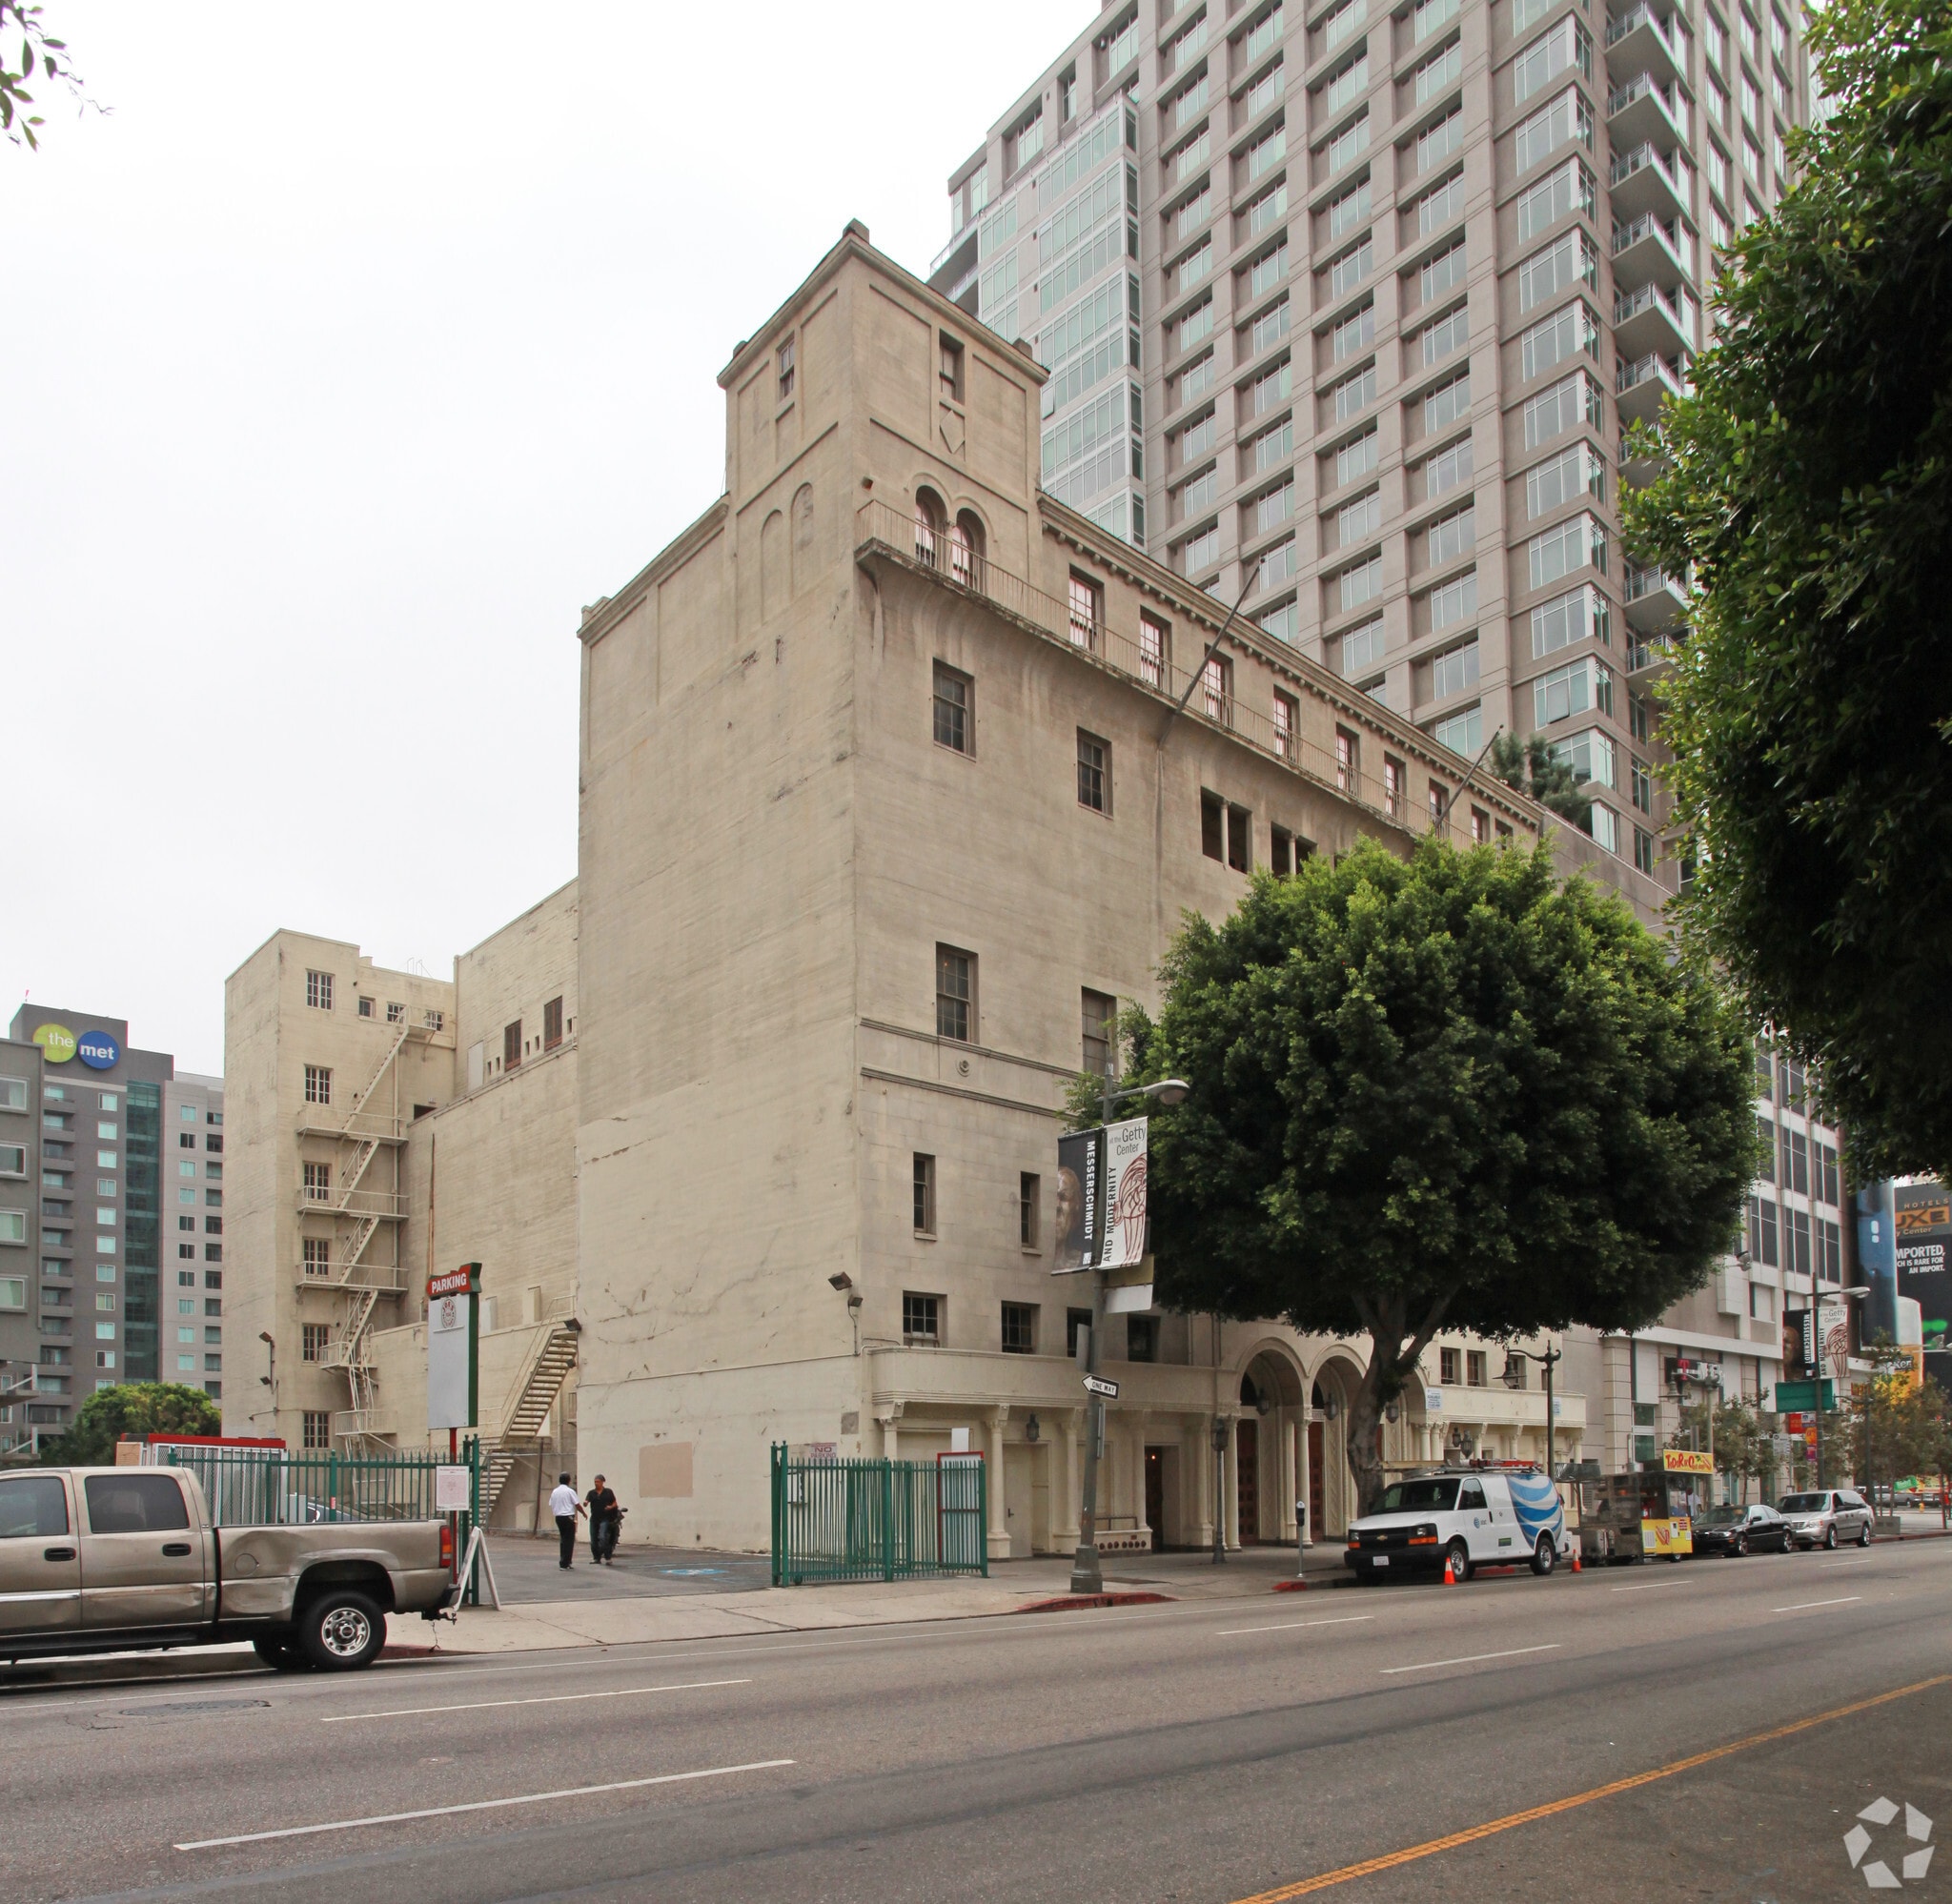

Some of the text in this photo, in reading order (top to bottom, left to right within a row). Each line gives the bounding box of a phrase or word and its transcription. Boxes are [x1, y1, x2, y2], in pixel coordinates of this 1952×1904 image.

[49, 1032, 73, 1048] the
[80, 1044, 114, 1060] met
[1122, 1126, 1147, 1143] Getty
[1116, 1144, 1139, 1156] Center
[1084, 1141, 1095, 1240] MESSERSCHMIDT
[1904, 1198, 1949, 1209] HOTELS
[1104, 1167, 1117, 1262] AND MODERNITY
[1896, 1209, 1946, 1229] UXE
[1896, 1245, 1946, 1259] MPORTED,
[432, 1273, 466, 1293] PARKING
[1104, 1385, 1115, 1393] WAY
